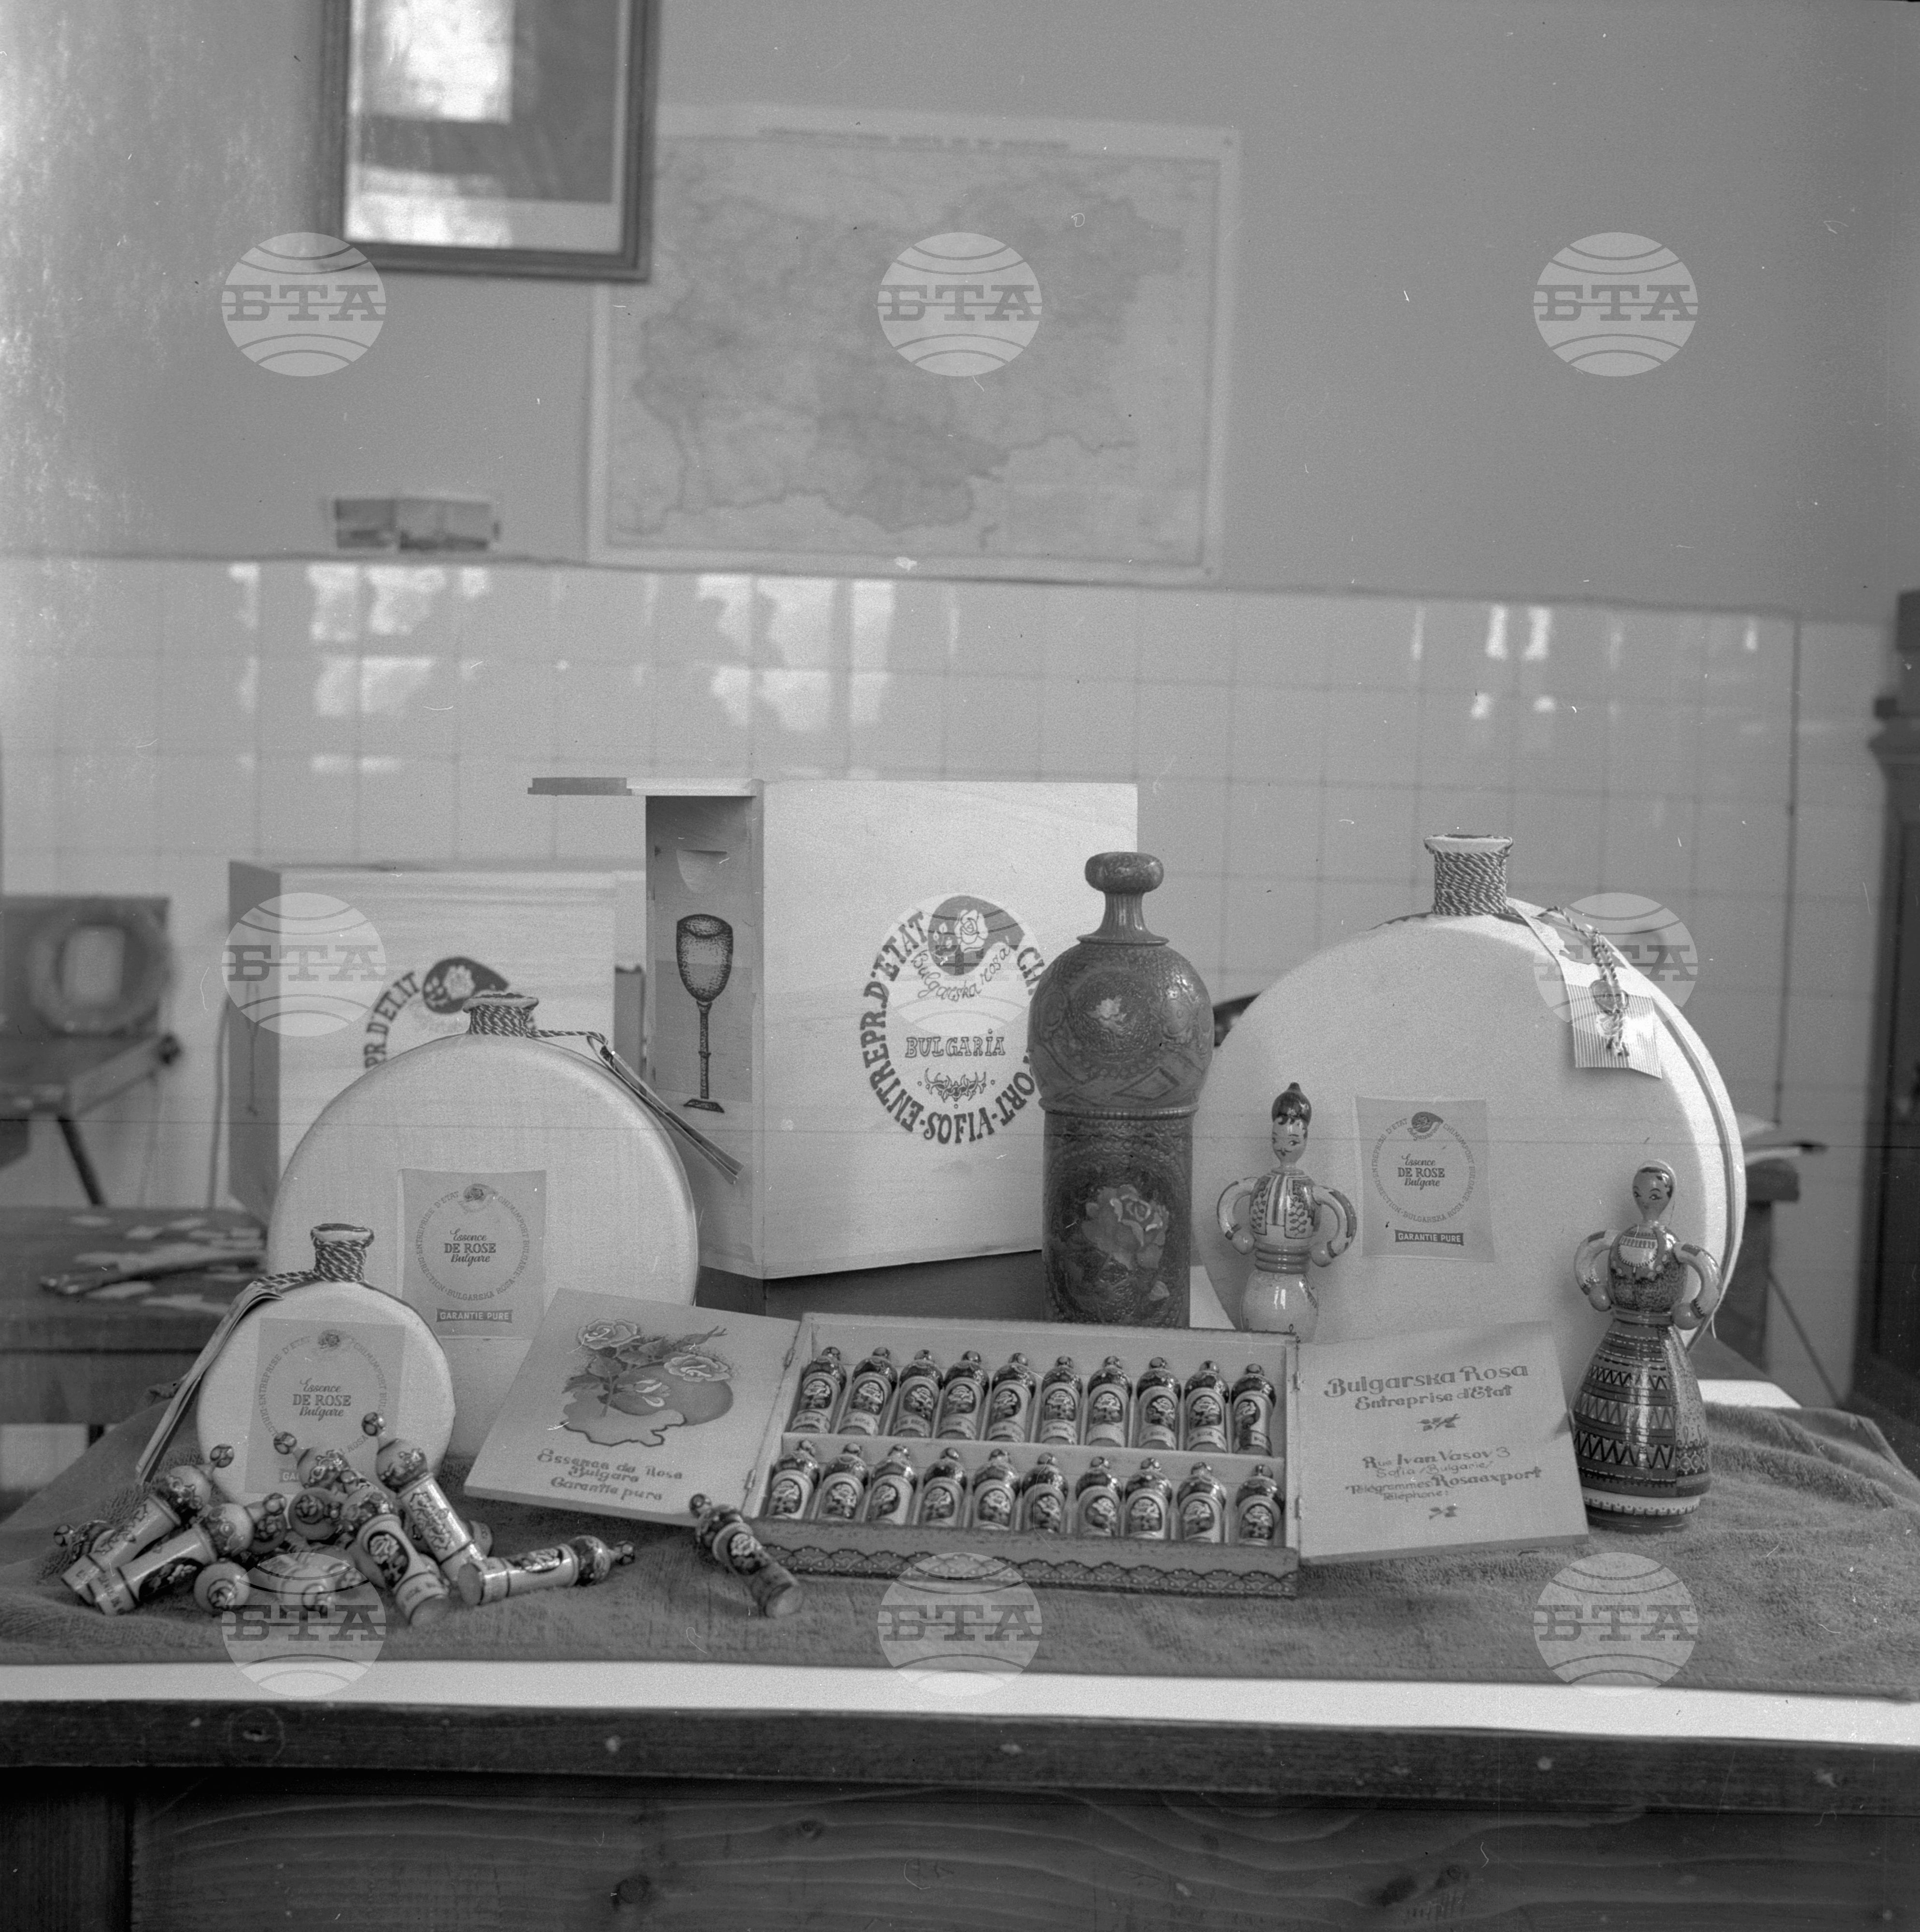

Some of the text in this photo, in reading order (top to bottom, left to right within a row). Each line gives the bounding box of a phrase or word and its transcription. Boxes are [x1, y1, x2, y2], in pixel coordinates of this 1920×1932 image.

[1401, 1153, 1436, 1166] Essence
[1398, 1167, 1445, 1178] DE ROSE
[1405, 1178, 1440, 1191] Bulgare
[450, 1228, 487, 1241] Essence
[1398, 1233, 1462, 1243] GARANTIE PURE
[444, 1243, 497, 1253] DE ROSE
[451, 1253, 491, 1267] Bulgare
[446, 1284, 495, 1301] BULGARSKA
[440, 1312, 509, 1320] GARANTIE PURE
[299, 1378, 341, 1392] Essence
[1324, 1365, 1530, 1398] Bulgarska Rosa
[292, 1393, 352, 1406] DE ROSE
[1354, 1384, 1513, 1411] Entreprise d'Etat
[299, 1406, 344, 1421] Bulgare
[1362, 1447, 1511, 1469] Rue Ivan Vasov 3
[1376, 1466, 1415, 1478] Sofia
